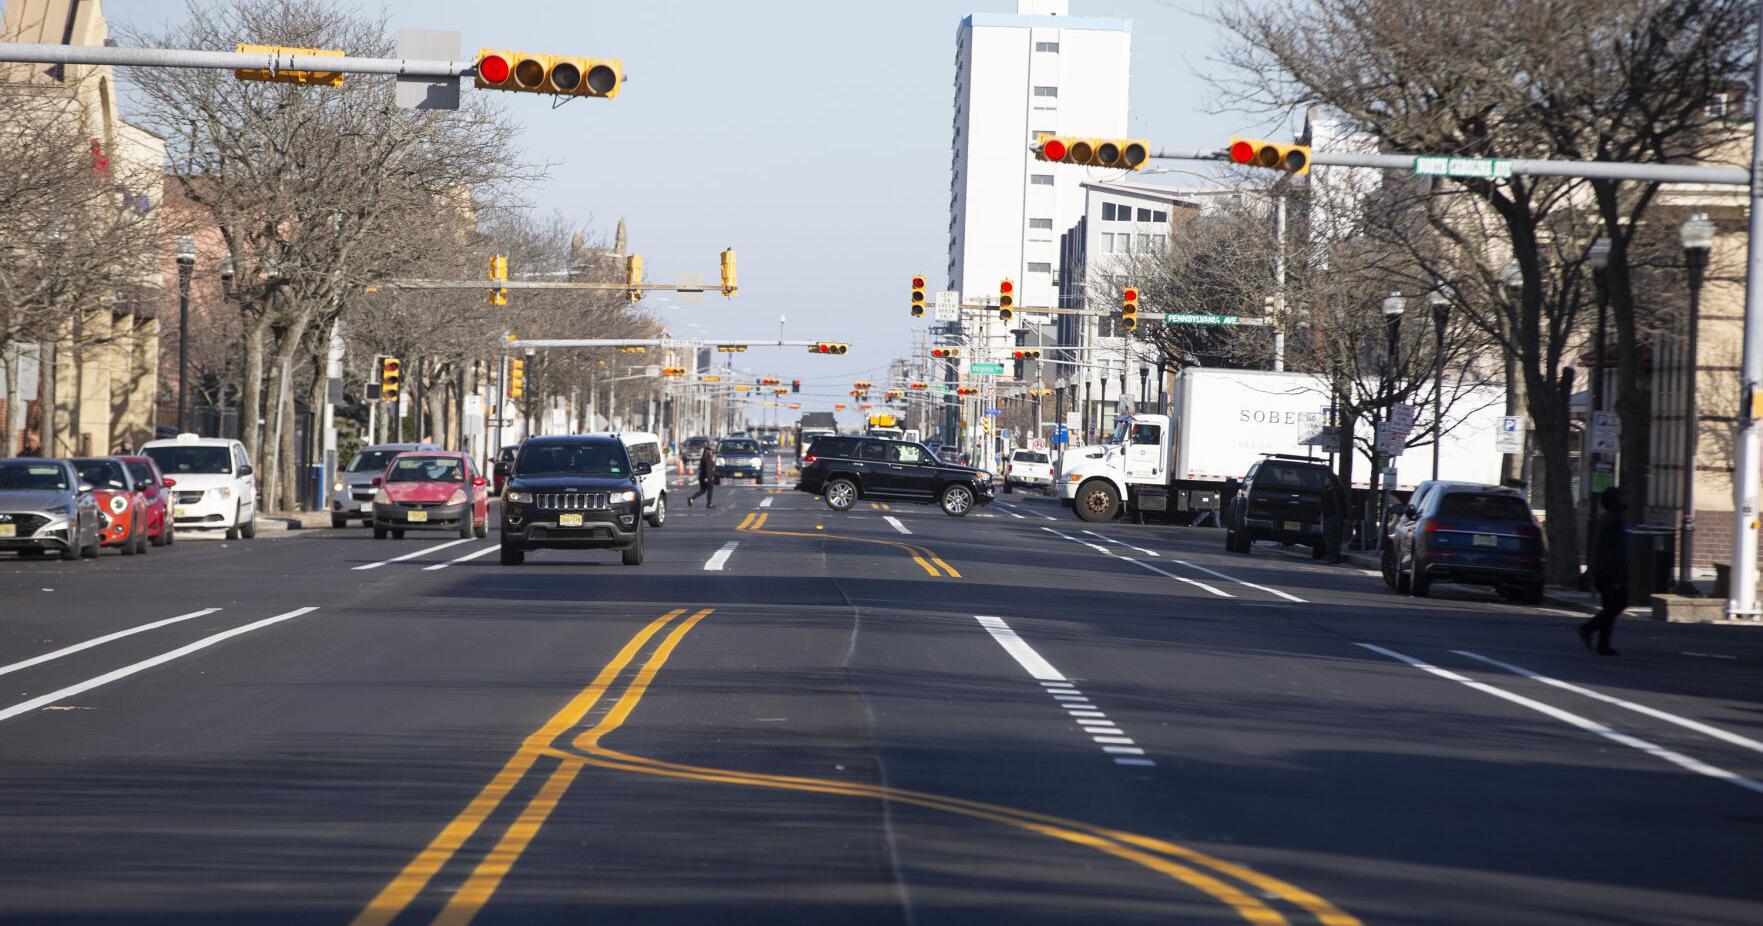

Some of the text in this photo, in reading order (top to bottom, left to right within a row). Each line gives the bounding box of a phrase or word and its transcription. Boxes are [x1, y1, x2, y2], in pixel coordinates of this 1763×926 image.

[1416, 157, 1448, 174] NORTH
[1449, 159, 1493, 176] CAROLINA
[1168, 315, 1220, 324] PENNSYLVANIA
